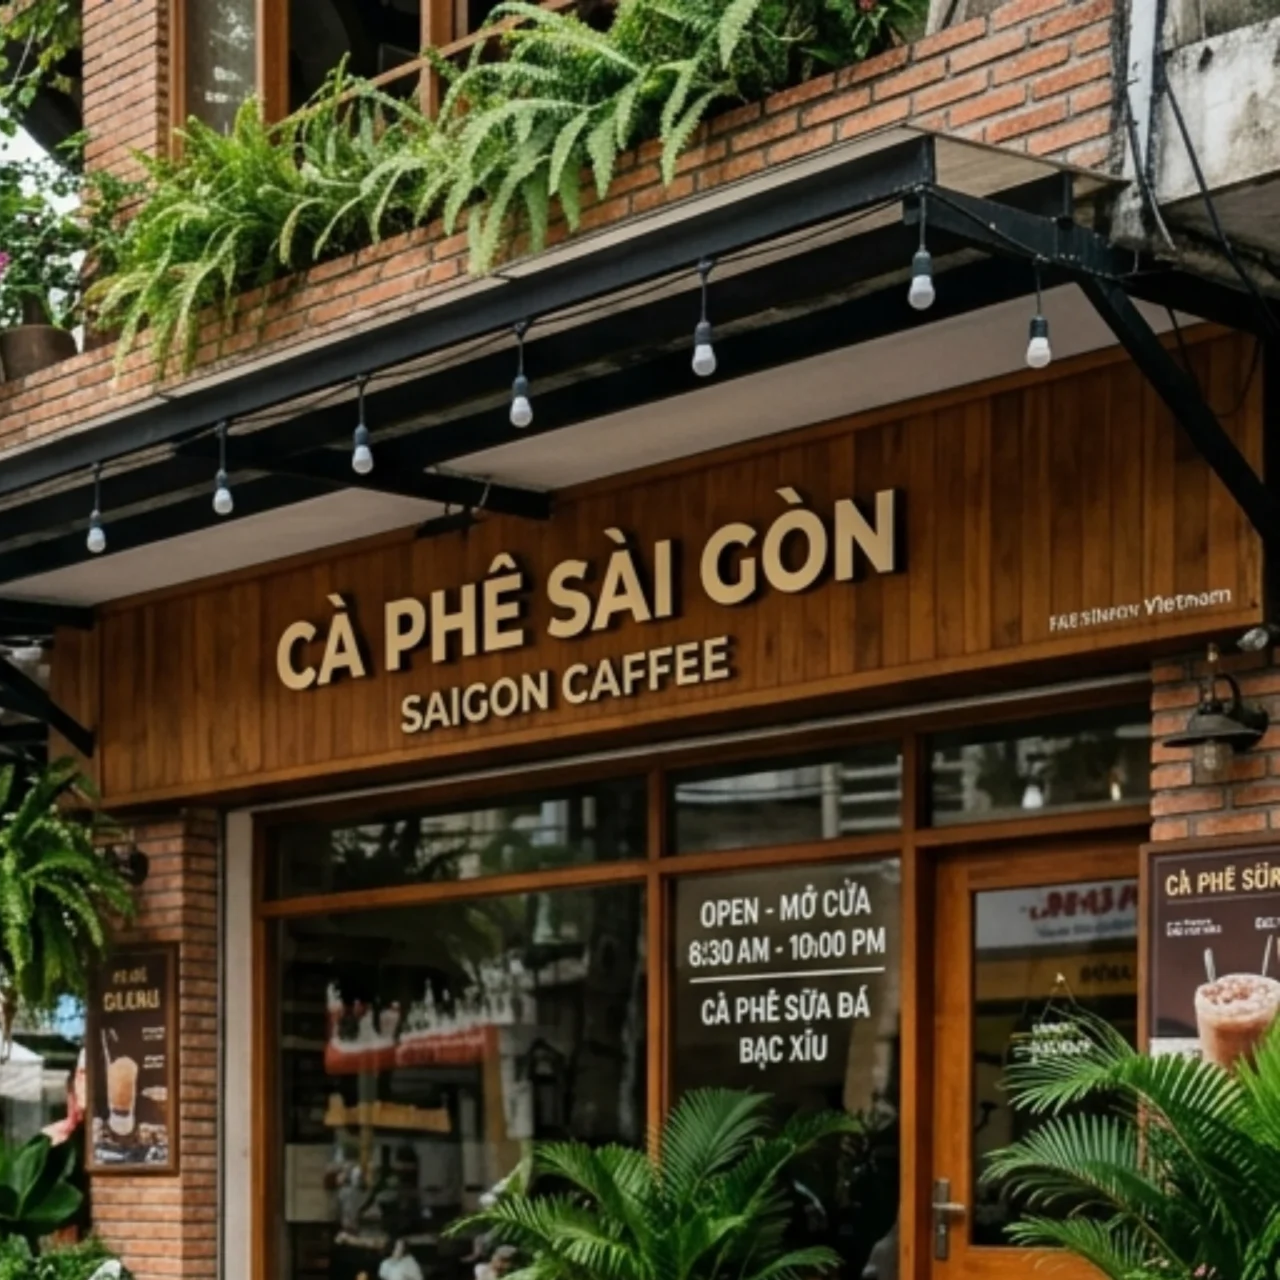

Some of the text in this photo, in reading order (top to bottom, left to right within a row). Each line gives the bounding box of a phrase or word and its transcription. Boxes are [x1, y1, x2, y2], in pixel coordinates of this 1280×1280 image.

[276, 487, 896, 690] CÀ PHÊ SÀI GÒN
[400, 636, 730, 733] SAIGON CAFFEE
[700, 897, 759, 928] OPEN
[737, 936, 770, 964] AM
[851, 927, 886, 956] PM
[739, 1034, 784, 1071] BẠC
